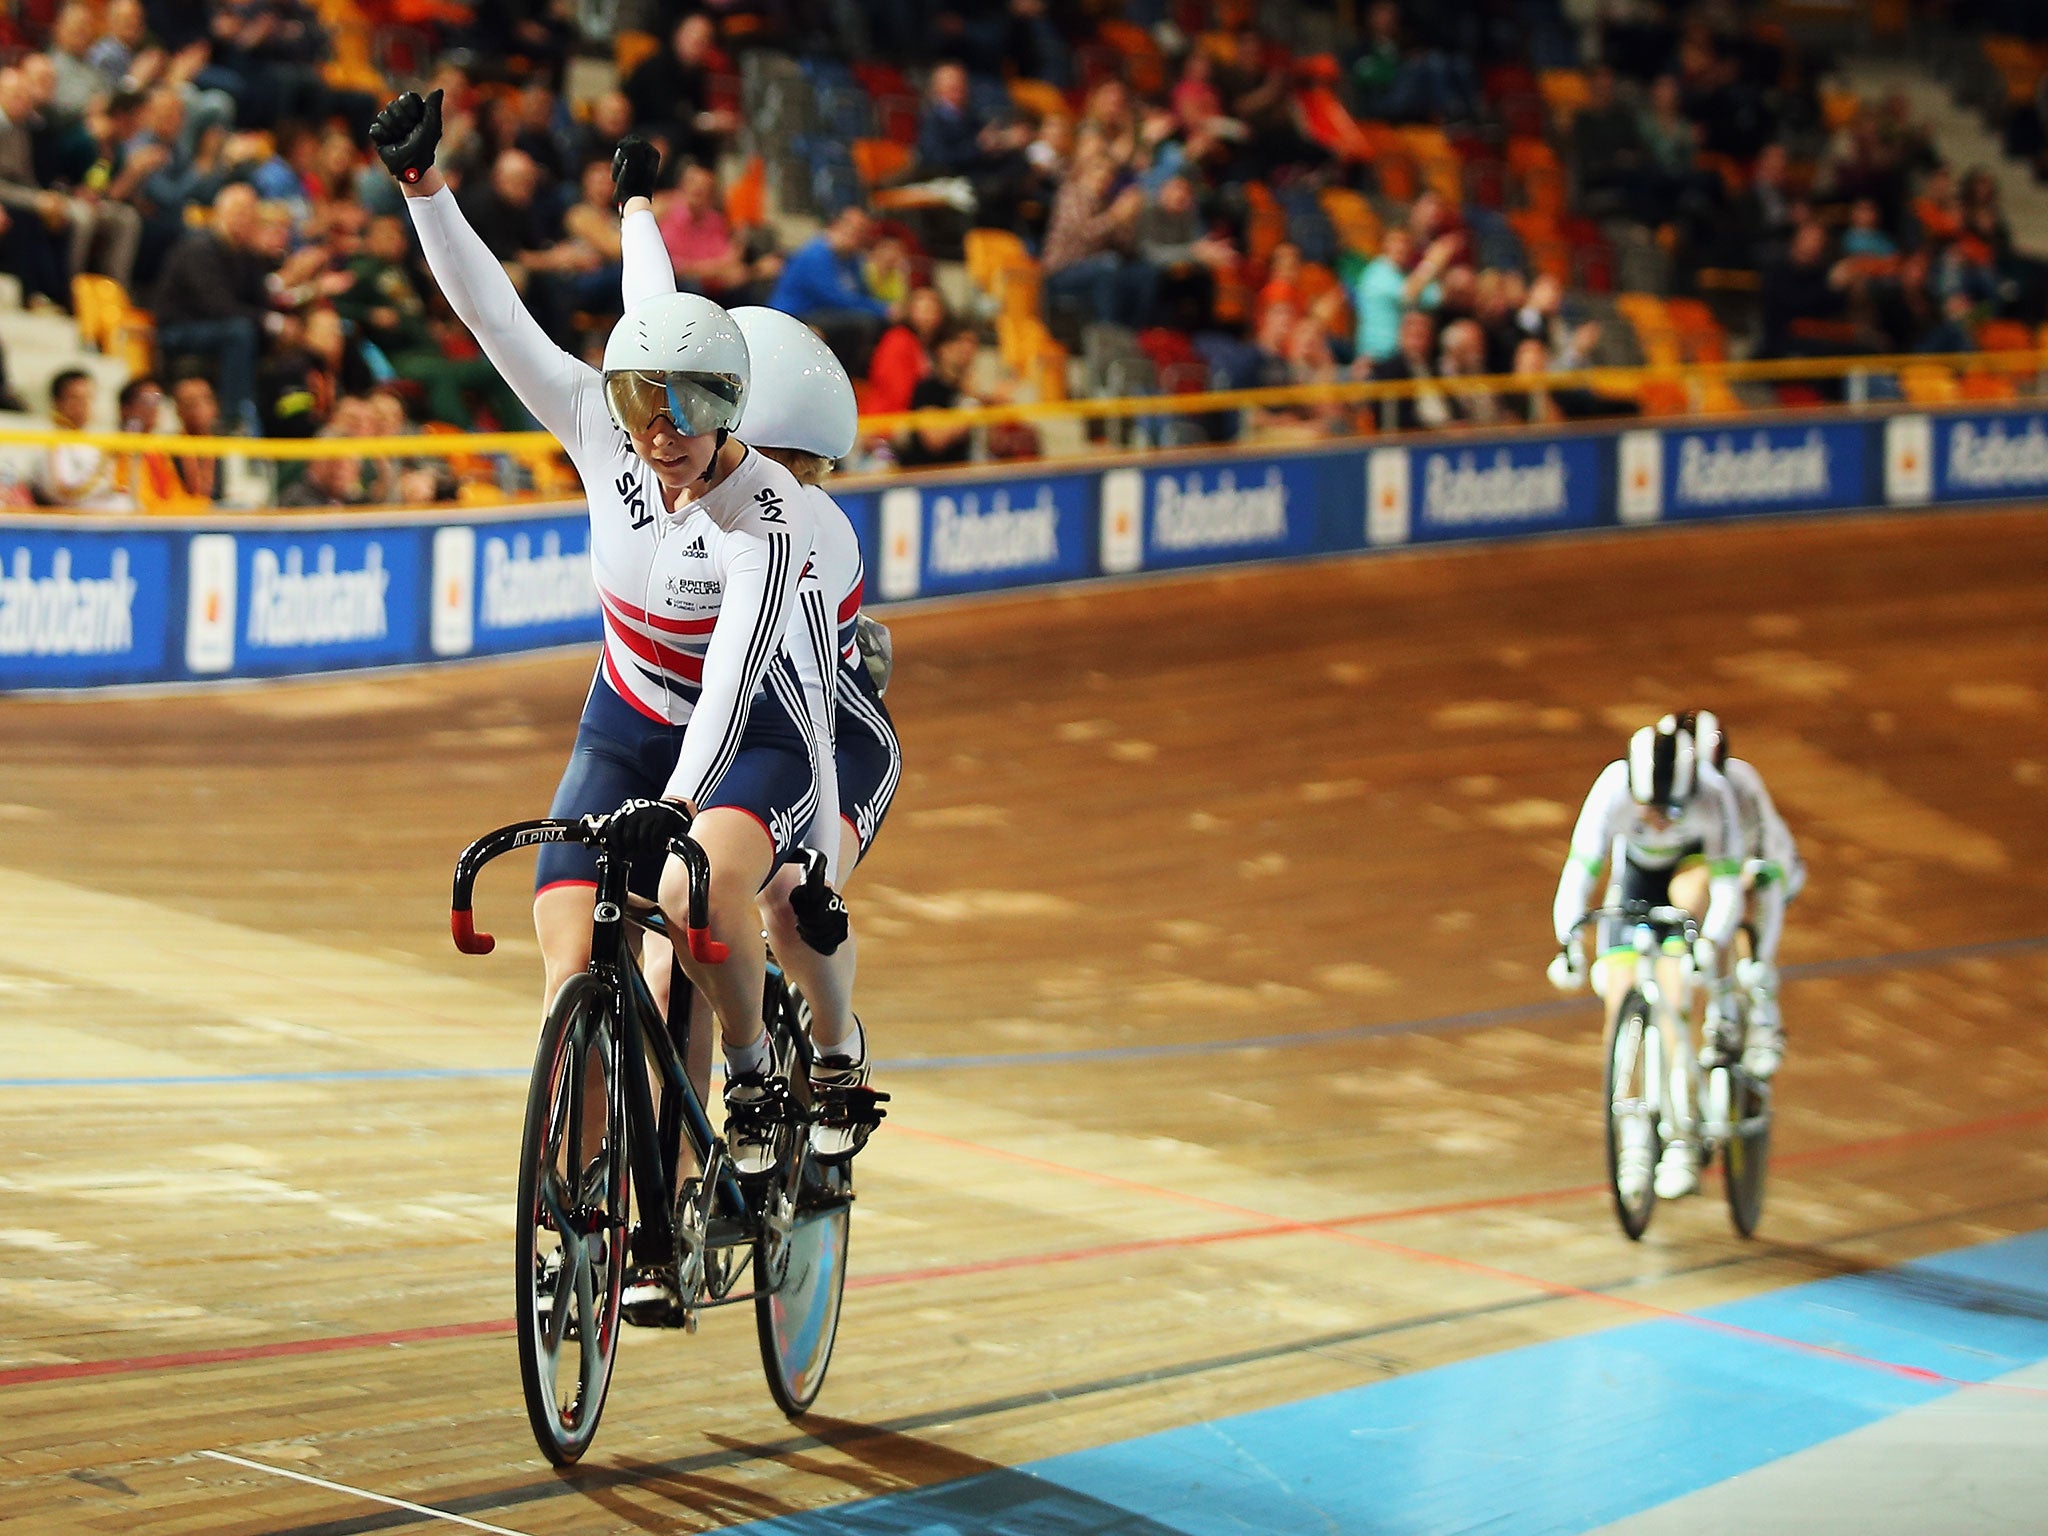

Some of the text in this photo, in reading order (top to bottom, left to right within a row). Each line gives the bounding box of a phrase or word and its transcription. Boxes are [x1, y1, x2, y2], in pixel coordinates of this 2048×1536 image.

[0, 546, 137, 656] abobank
[247, 542, 389, 647] Rabobank
[512, 829, 567, 848] ALPINA
